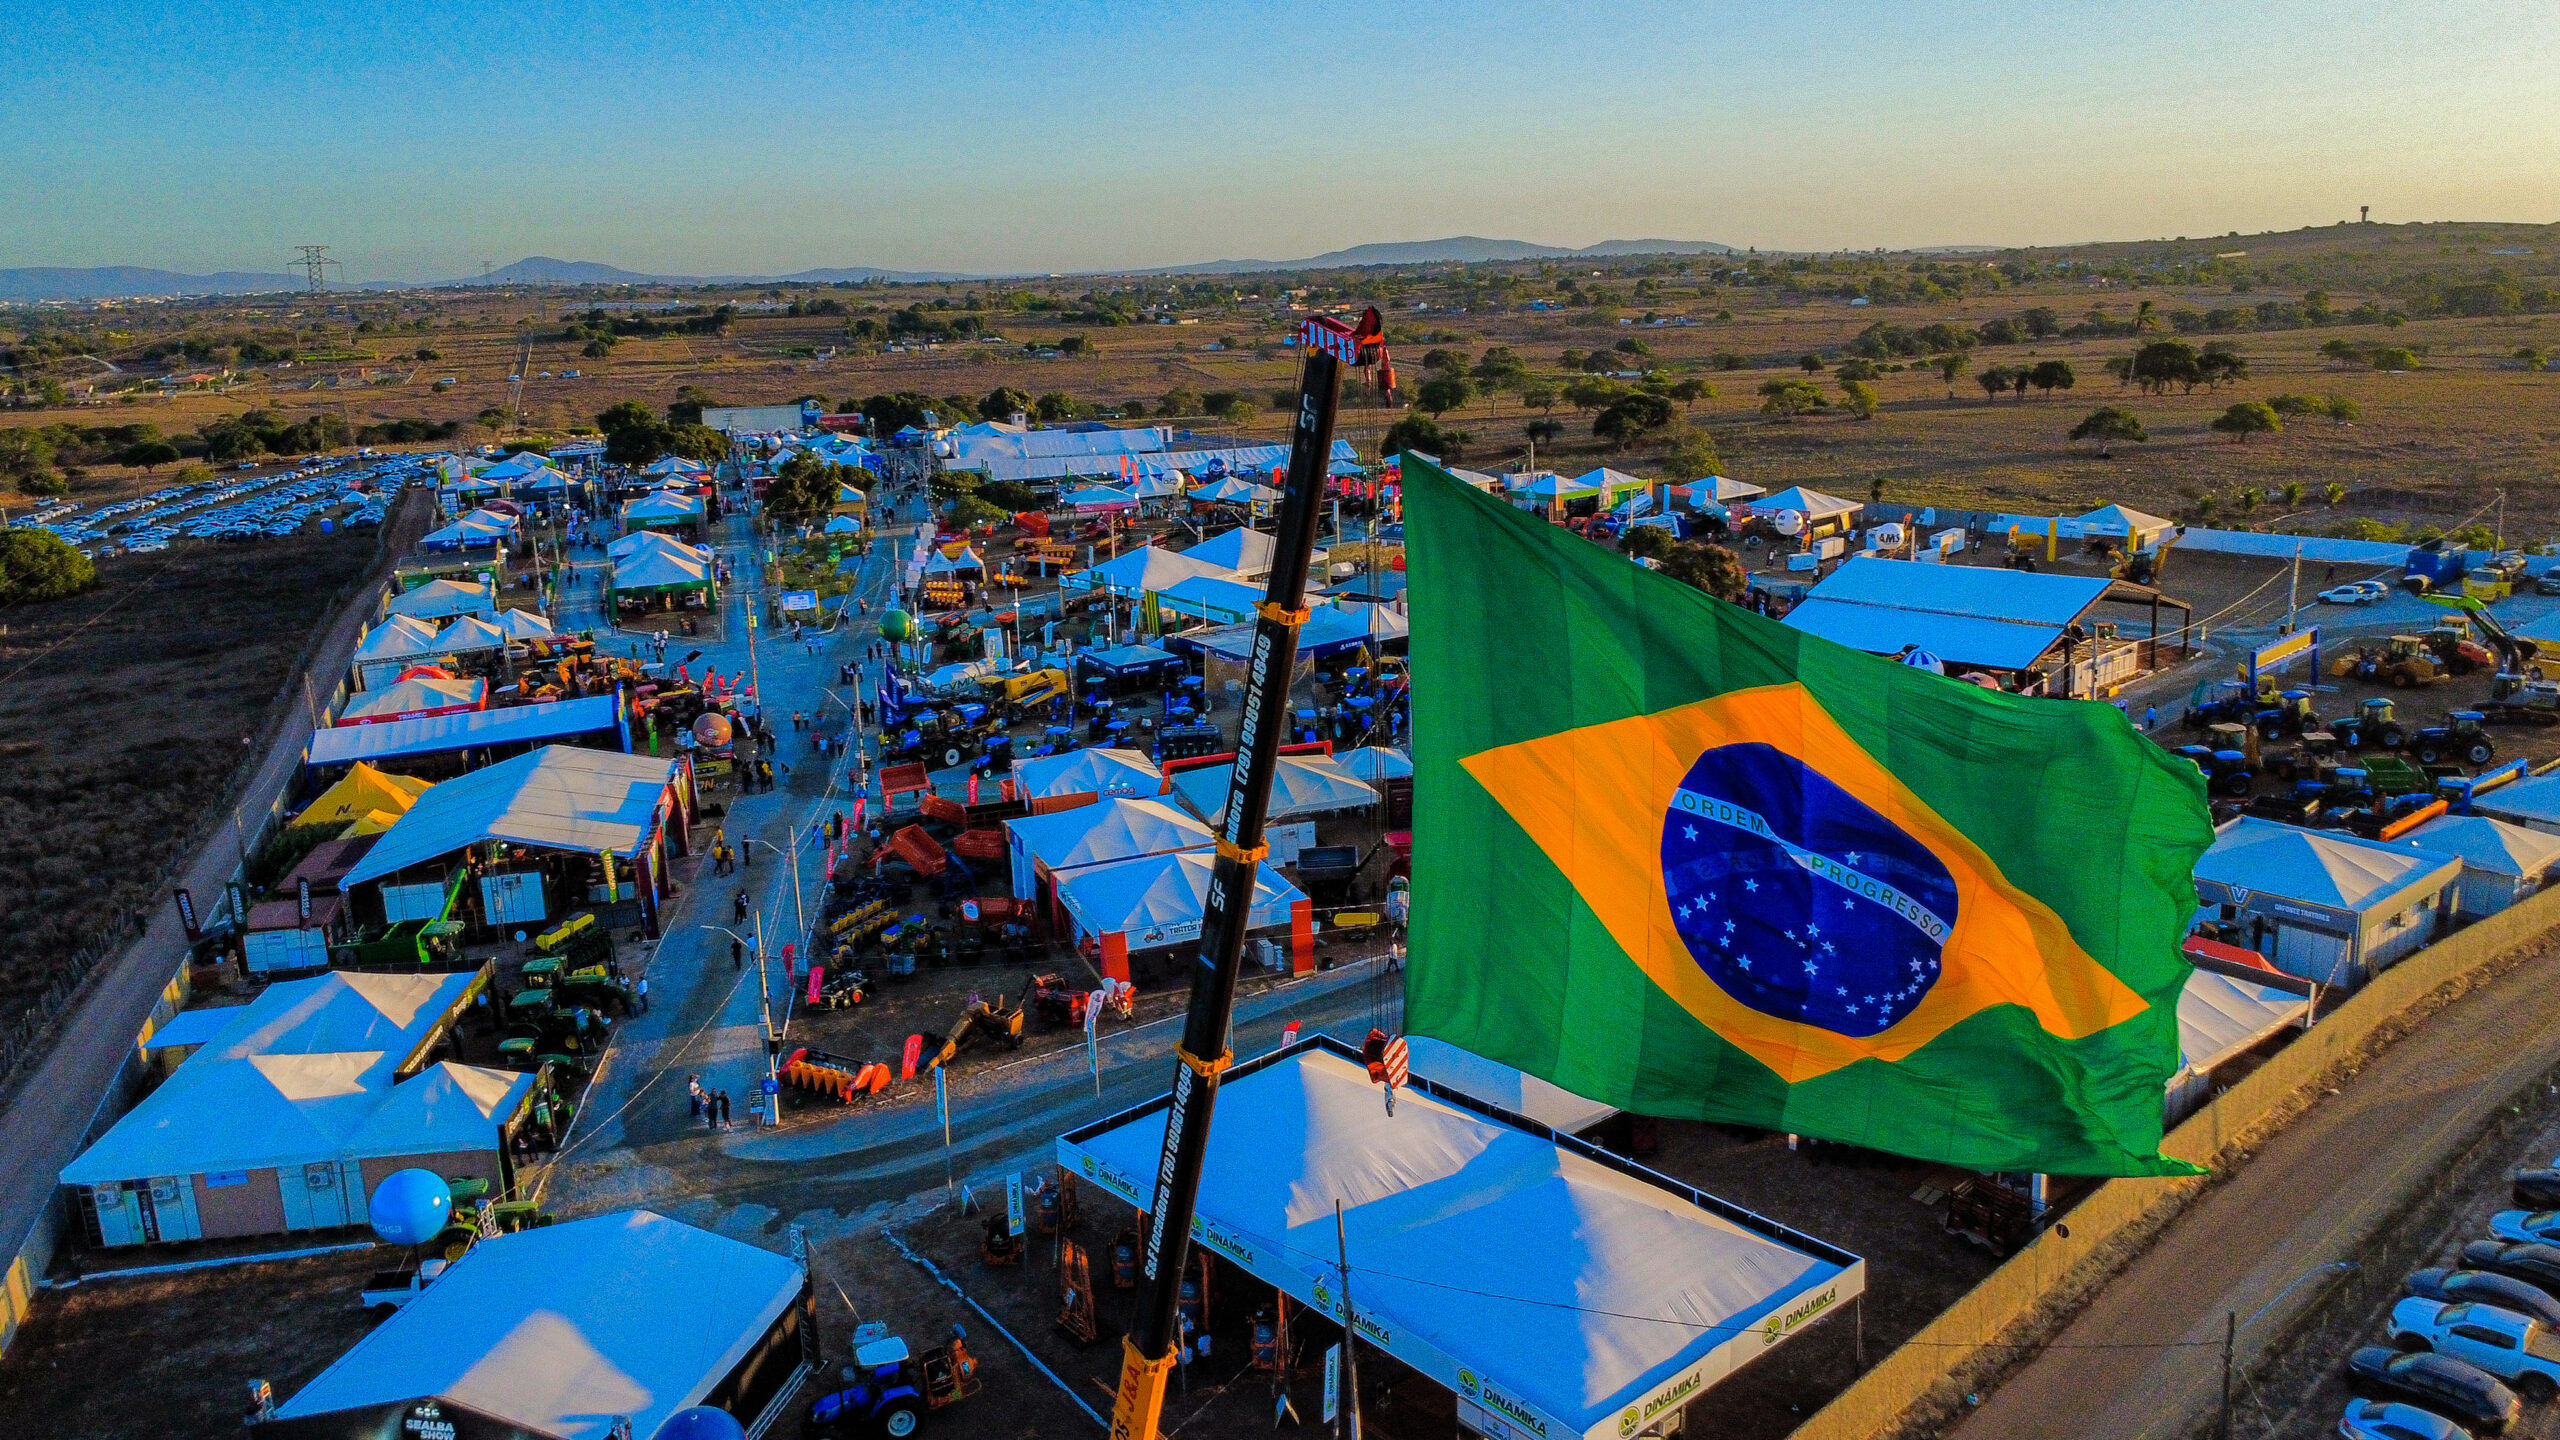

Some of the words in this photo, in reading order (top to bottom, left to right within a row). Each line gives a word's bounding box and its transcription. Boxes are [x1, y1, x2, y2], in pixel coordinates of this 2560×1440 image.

[1879, 531, 1901, 544] AMS
[1252, 634, 1271, 686] 4849
[1681, 793, 1765, 834] ORDEM
[1211, 878, 1227, 912] SF
[1811, 856, 1943, 937] PROGRESSO
[406, 1419, 454, 1432] SEALBA
[420, 1430, 456, 1440] SHOW
